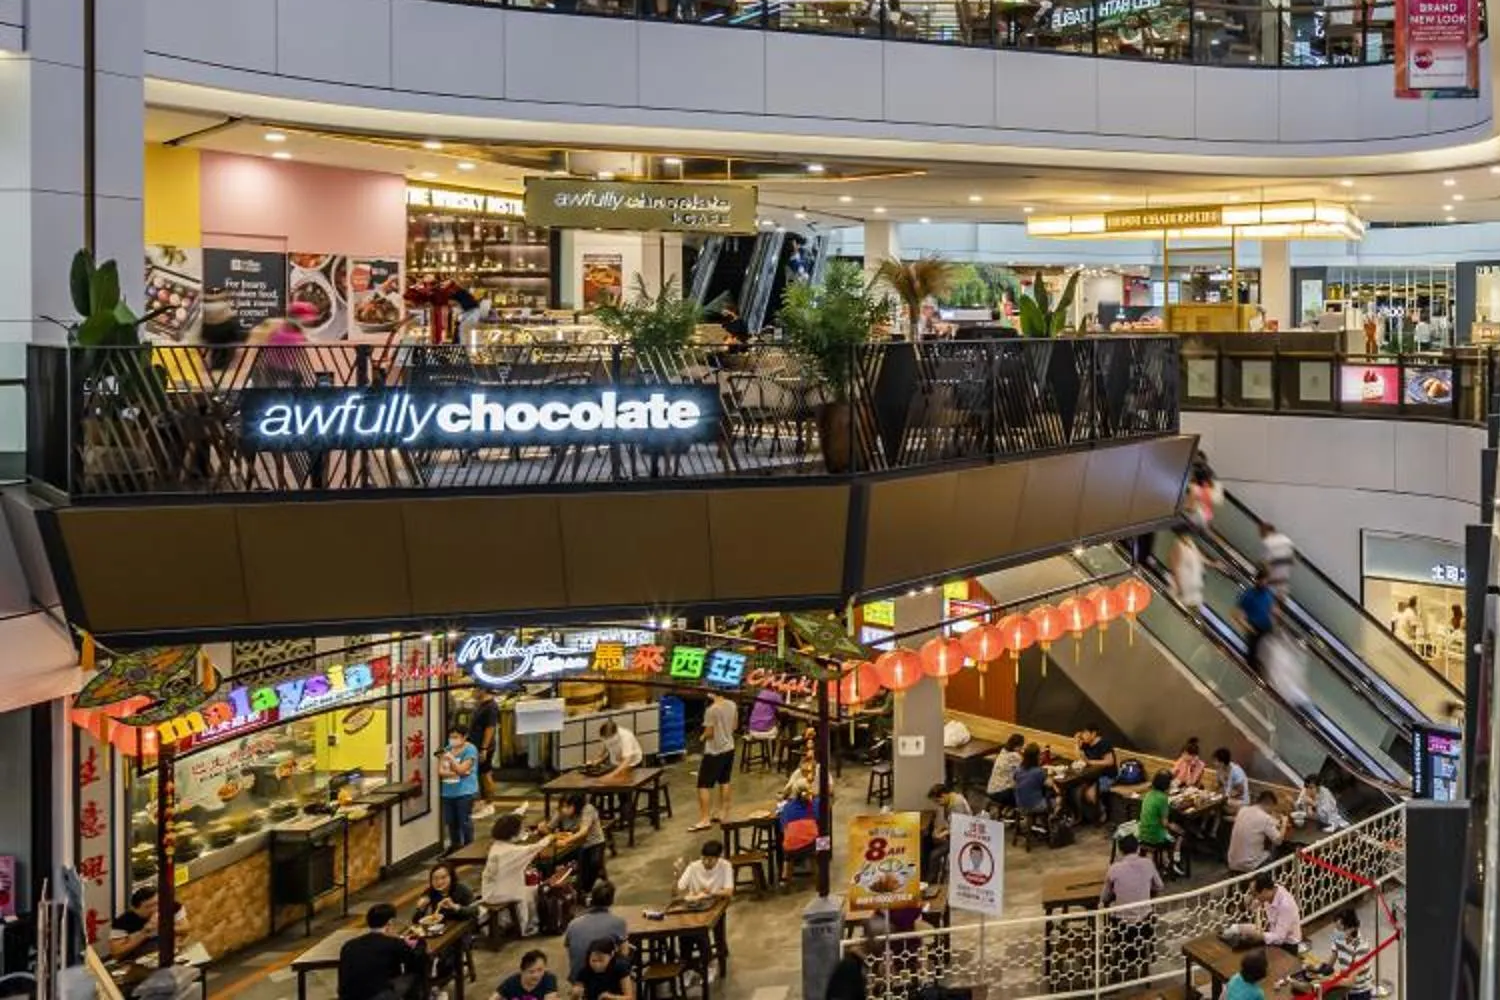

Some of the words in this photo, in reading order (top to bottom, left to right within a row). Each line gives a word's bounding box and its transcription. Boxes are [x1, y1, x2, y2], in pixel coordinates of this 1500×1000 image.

[1409, 15, 1435, 24] NEW
[1437, 14, 1467, 24] LOOK
[1419, 3, 1457, 13] BRAND
[554, 190, 624, 211] awfully
[260, 396, 436, 442] awfully
[437, 391, 701, 433] chocolate
[592, 641, 747, 687] 馬來西亞
[156, 663, 375, 746] malaysia
